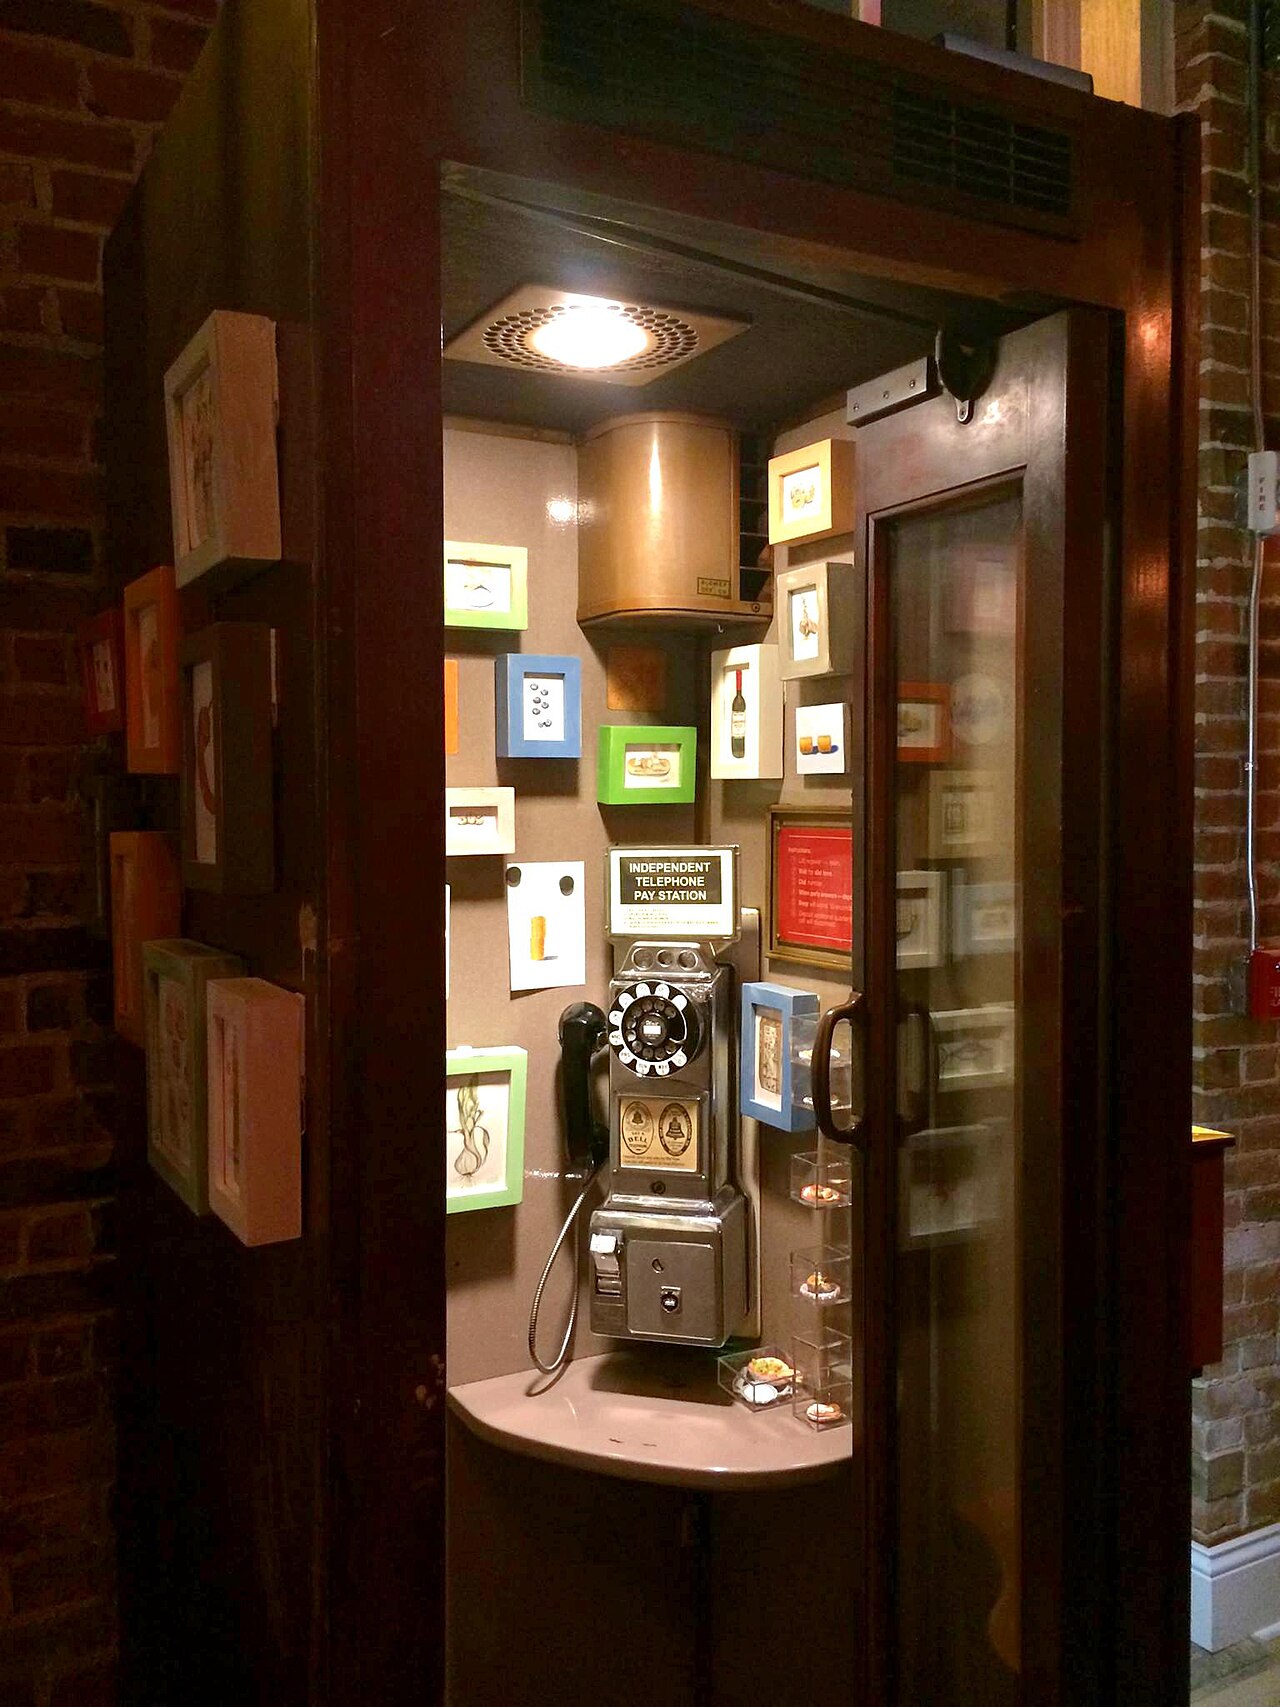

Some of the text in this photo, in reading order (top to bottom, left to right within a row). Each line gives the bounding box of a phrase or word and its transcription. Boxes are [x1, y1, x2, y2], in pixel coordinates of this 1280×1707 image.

[629, 862, 711, 873] INDEPENDENT
[635, 876, 705, 887] TELEPHONE
[634, 890, 707, 901] PAY STATION
